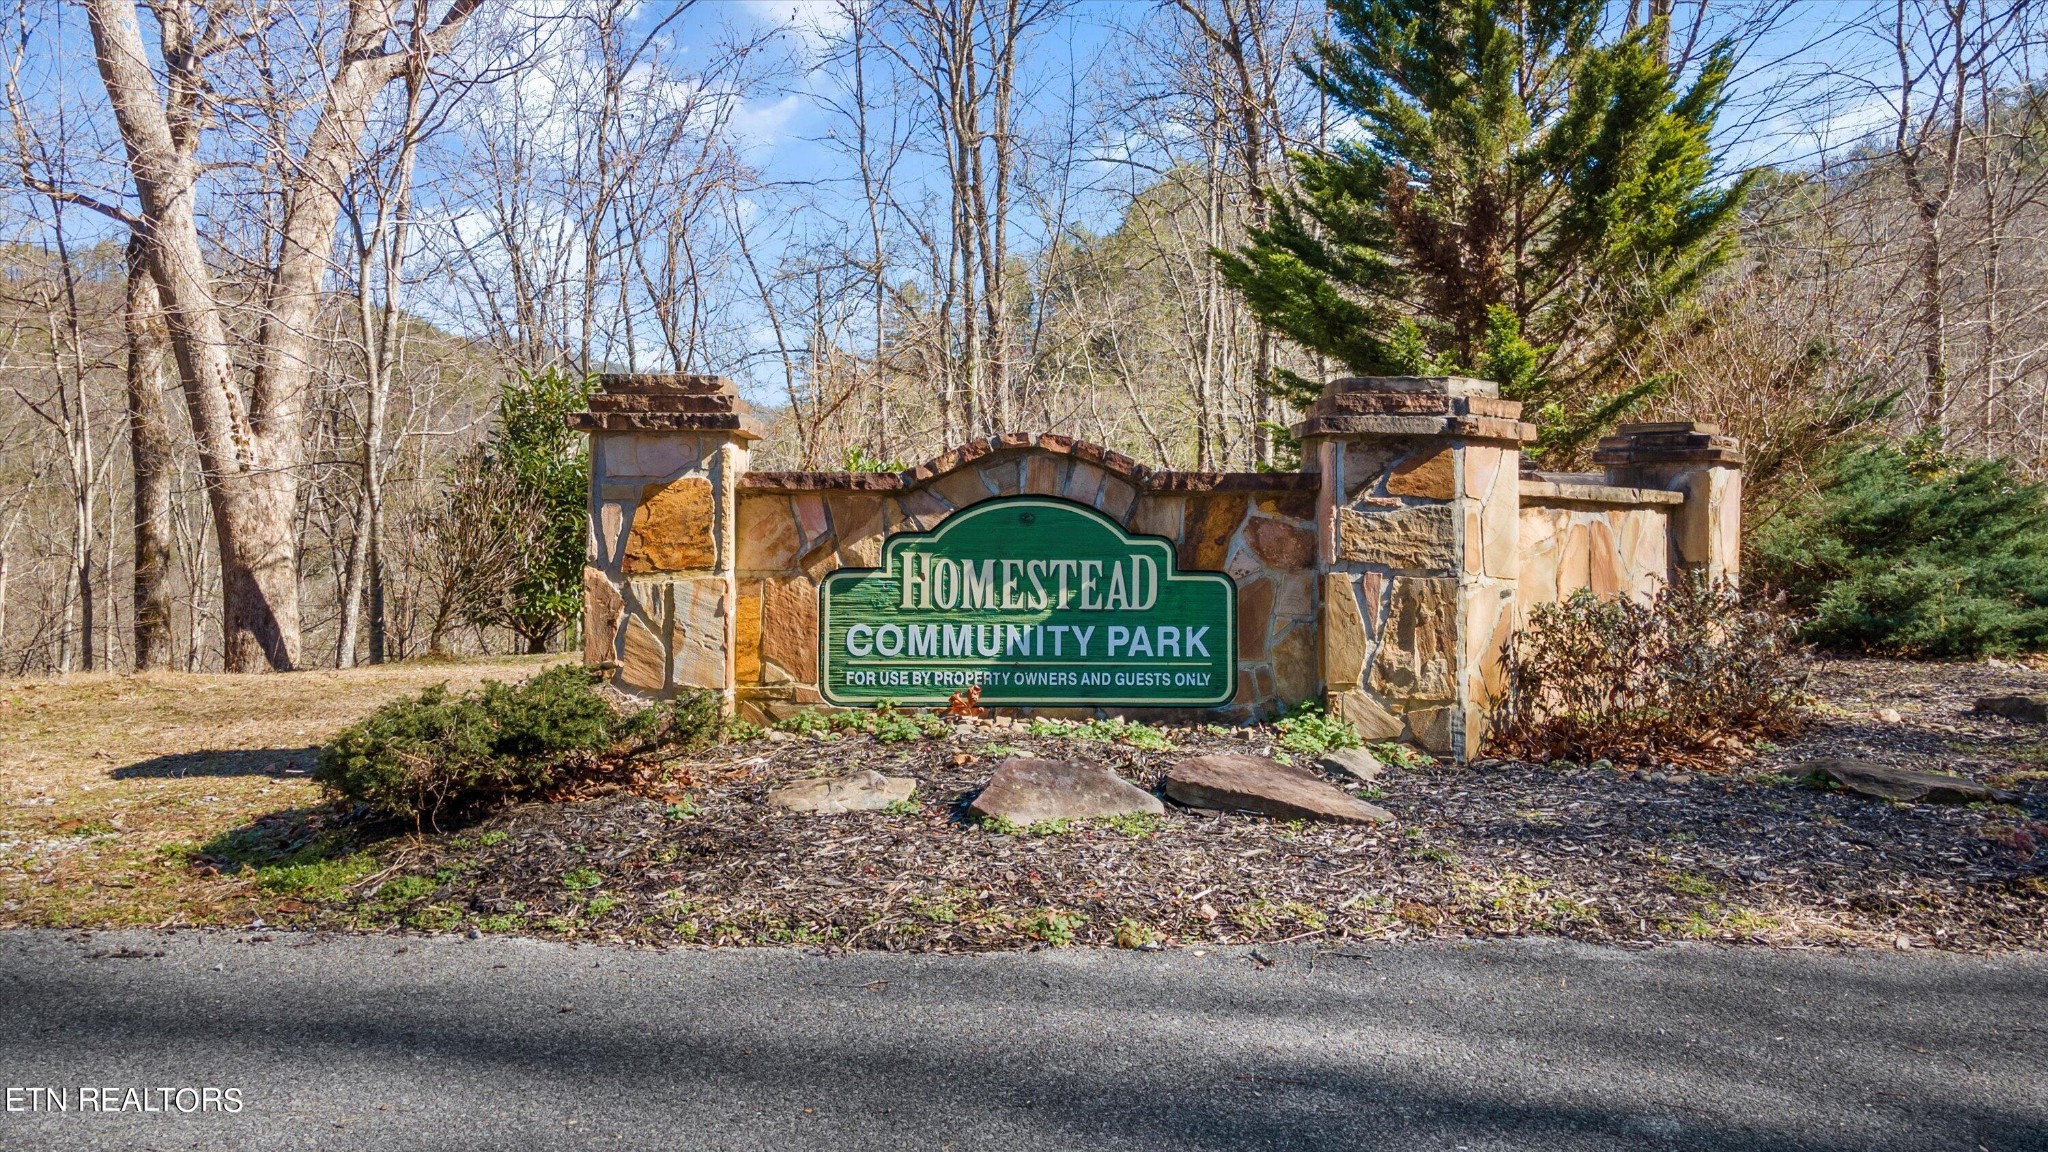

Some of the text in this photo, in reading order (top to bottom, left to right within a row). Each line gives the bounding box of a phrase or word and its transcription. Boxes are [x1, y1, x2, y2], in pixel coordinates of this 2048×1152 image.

[899, 552, 1158, 611] HOMESTEAD
[846, 624, 1211, 657] COMMUNITY PARK
[846, 671, 1212, 688] FOR USE BY PROPERTY OWNERS AND GUESTS ONLY
